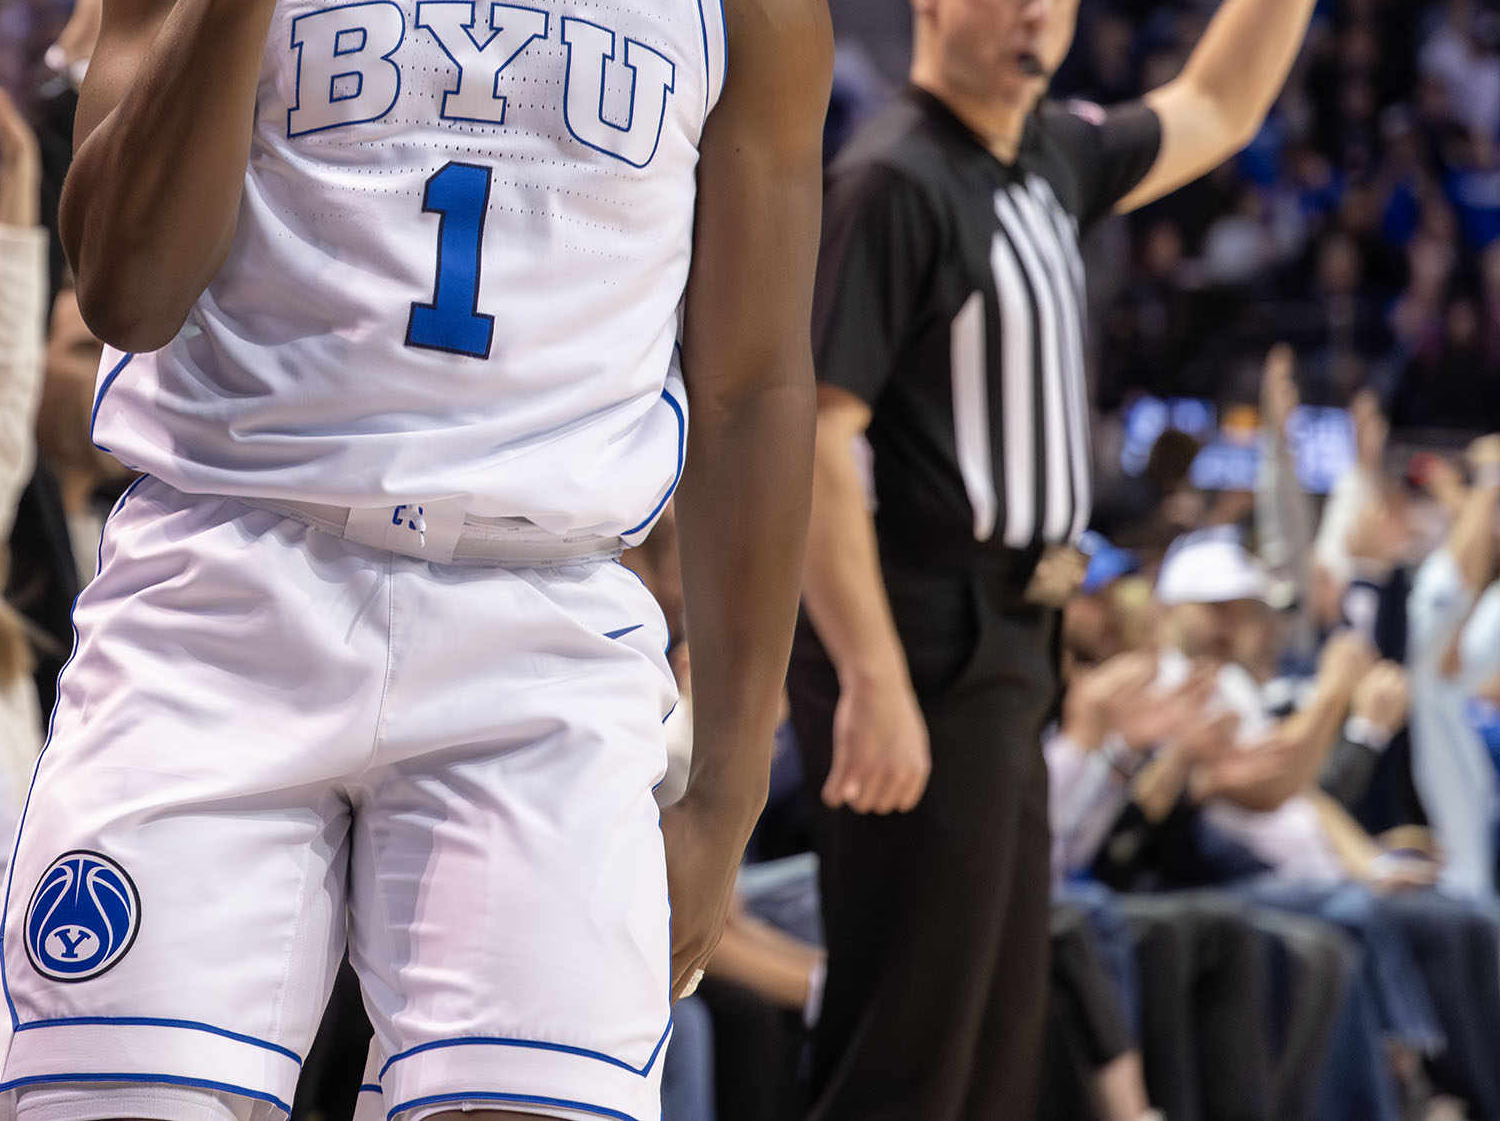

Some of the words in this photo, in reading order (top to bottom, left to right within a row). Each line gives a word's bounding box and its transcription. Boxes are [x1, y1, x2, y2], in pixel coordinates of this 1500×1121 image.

[287, 0, 676, 169] BYU
[404, 160, 496, 361] 1
[53, 928, 92, 959] Y
